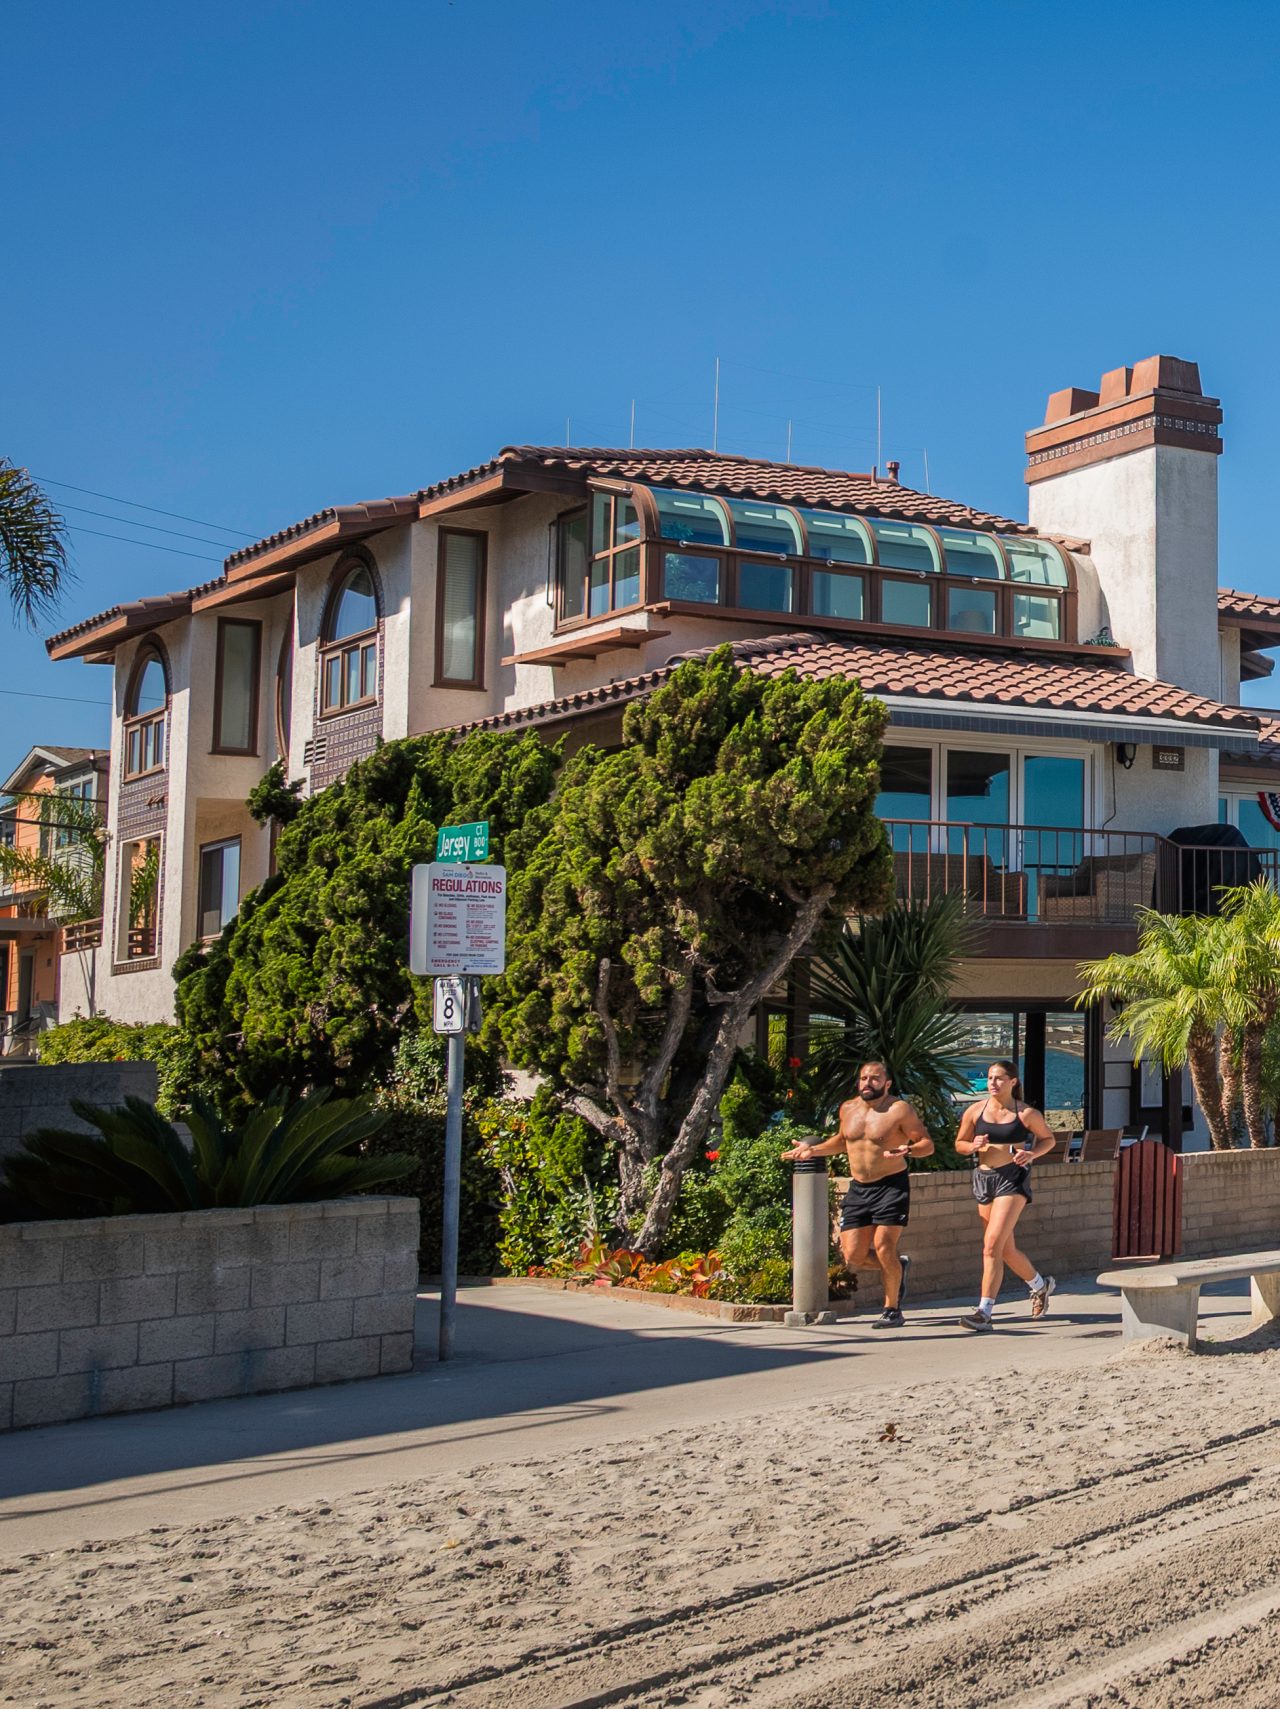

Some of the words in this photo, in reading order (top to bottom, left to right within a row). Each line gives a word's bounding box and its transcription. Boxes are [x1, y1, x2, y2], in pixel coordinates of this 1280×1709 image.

[438, 833, 470, 861] Jersey
[432, 878, 502, 894] REGULATIONS
[443, 997, 454, 1019] 8
